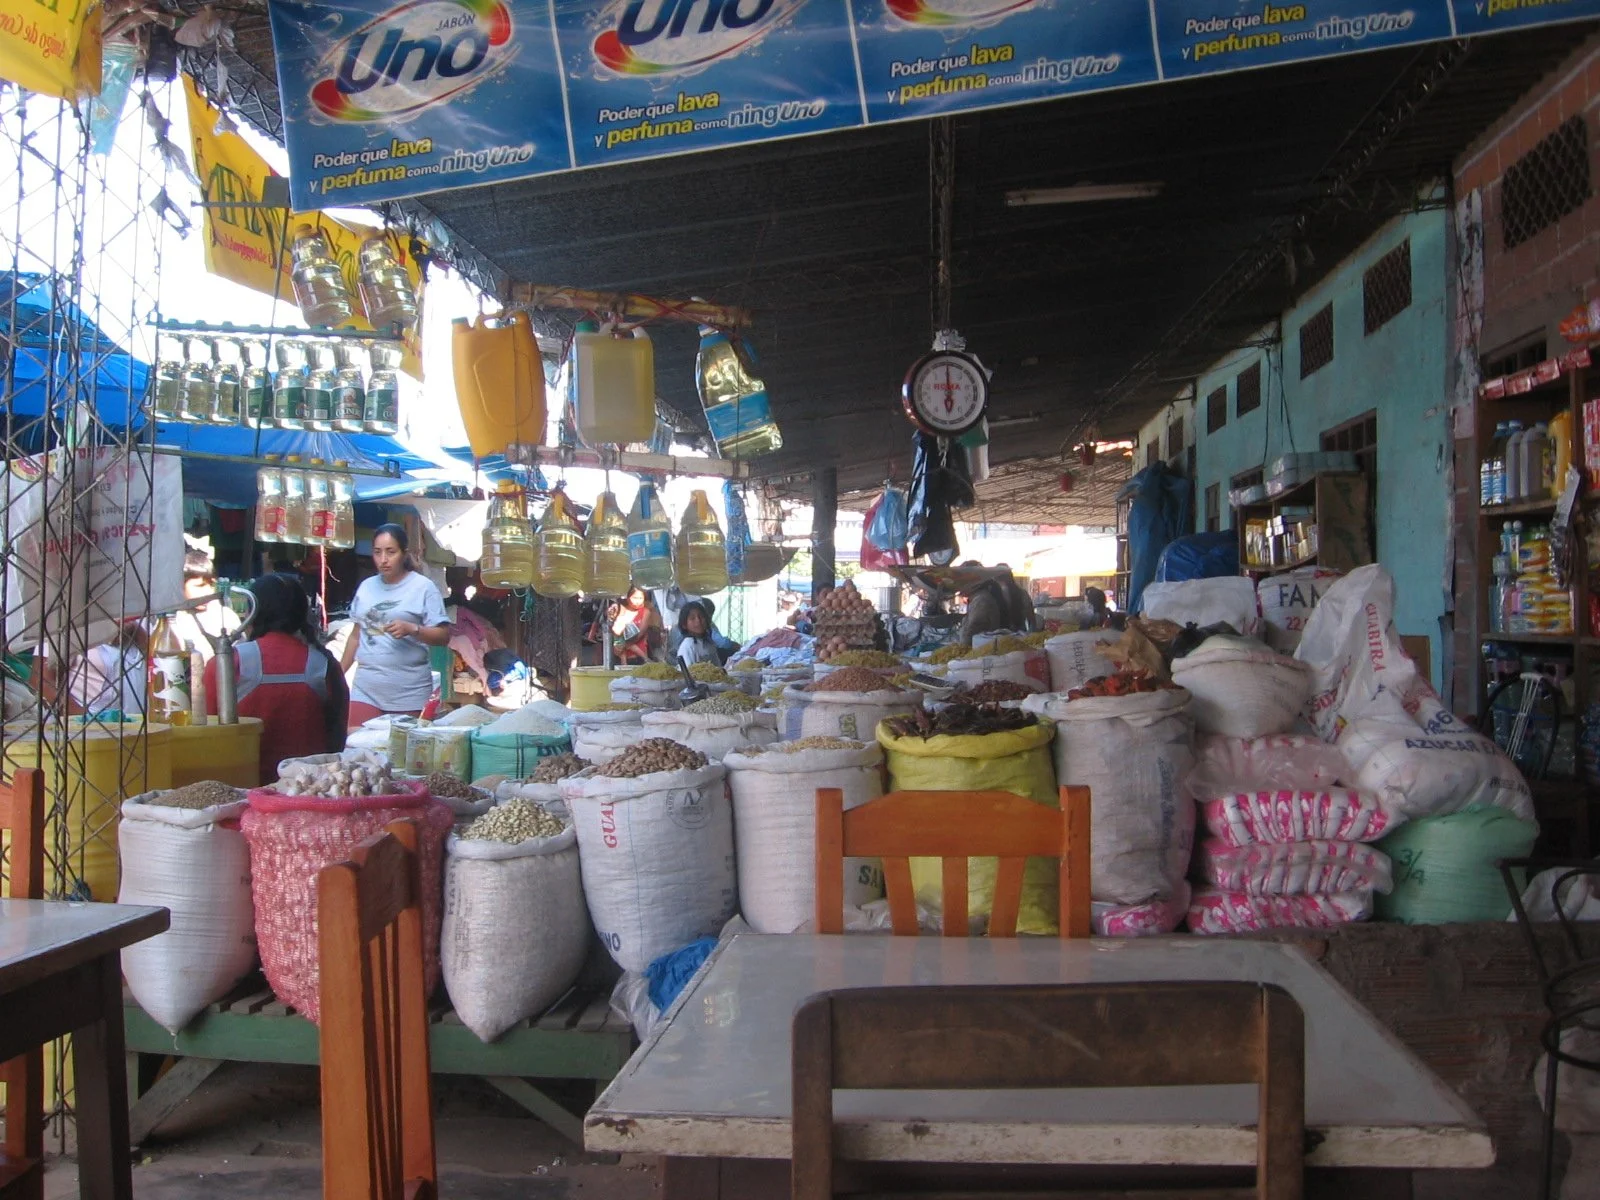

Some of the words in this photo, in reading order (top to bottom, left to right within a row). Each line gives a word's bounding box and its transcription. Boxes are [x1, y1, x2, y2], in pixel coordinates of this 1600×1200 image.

[436, 13, 476, 31] JABÓN
[1185, 17, 1230, 35] Poder
[1231, 14, 1261, 31] que
[1263, 4, 1306, 25] lava
[336, 28, 490, 95] Uno
[890, 59, 938, 79] Poder
[938, 54, 968, 73] que
[970, 43, 1014, 67] lava
[1181, 47, 1190, 60] y
[1194, 30, 1280, 61] perfuma
[1282, 31, 1316, 43] como
[887, 87, 897, 104] y
[899, 72, 987, 106] perfuma
[988, 73, 1023, 87] como
[598, 106, 645, 124] Poder
[645, 102, 675, 120] que
[677, 91, 720, 114] lava
[594, 133, 604, 148] y
[606, 118, 694, 150] perfuma
[694, 118, 728, 131] como
[313, 151, 360, 169] Poder
[360, 148, 389, 166] que
[391, 137, 433, 158] lava
[309, 179, 319, 194] y
[321, 164, 407, 195] perfuma
[407, 165, 440, 178] como
[1404, 738, 1480, 753] AZUCAR
